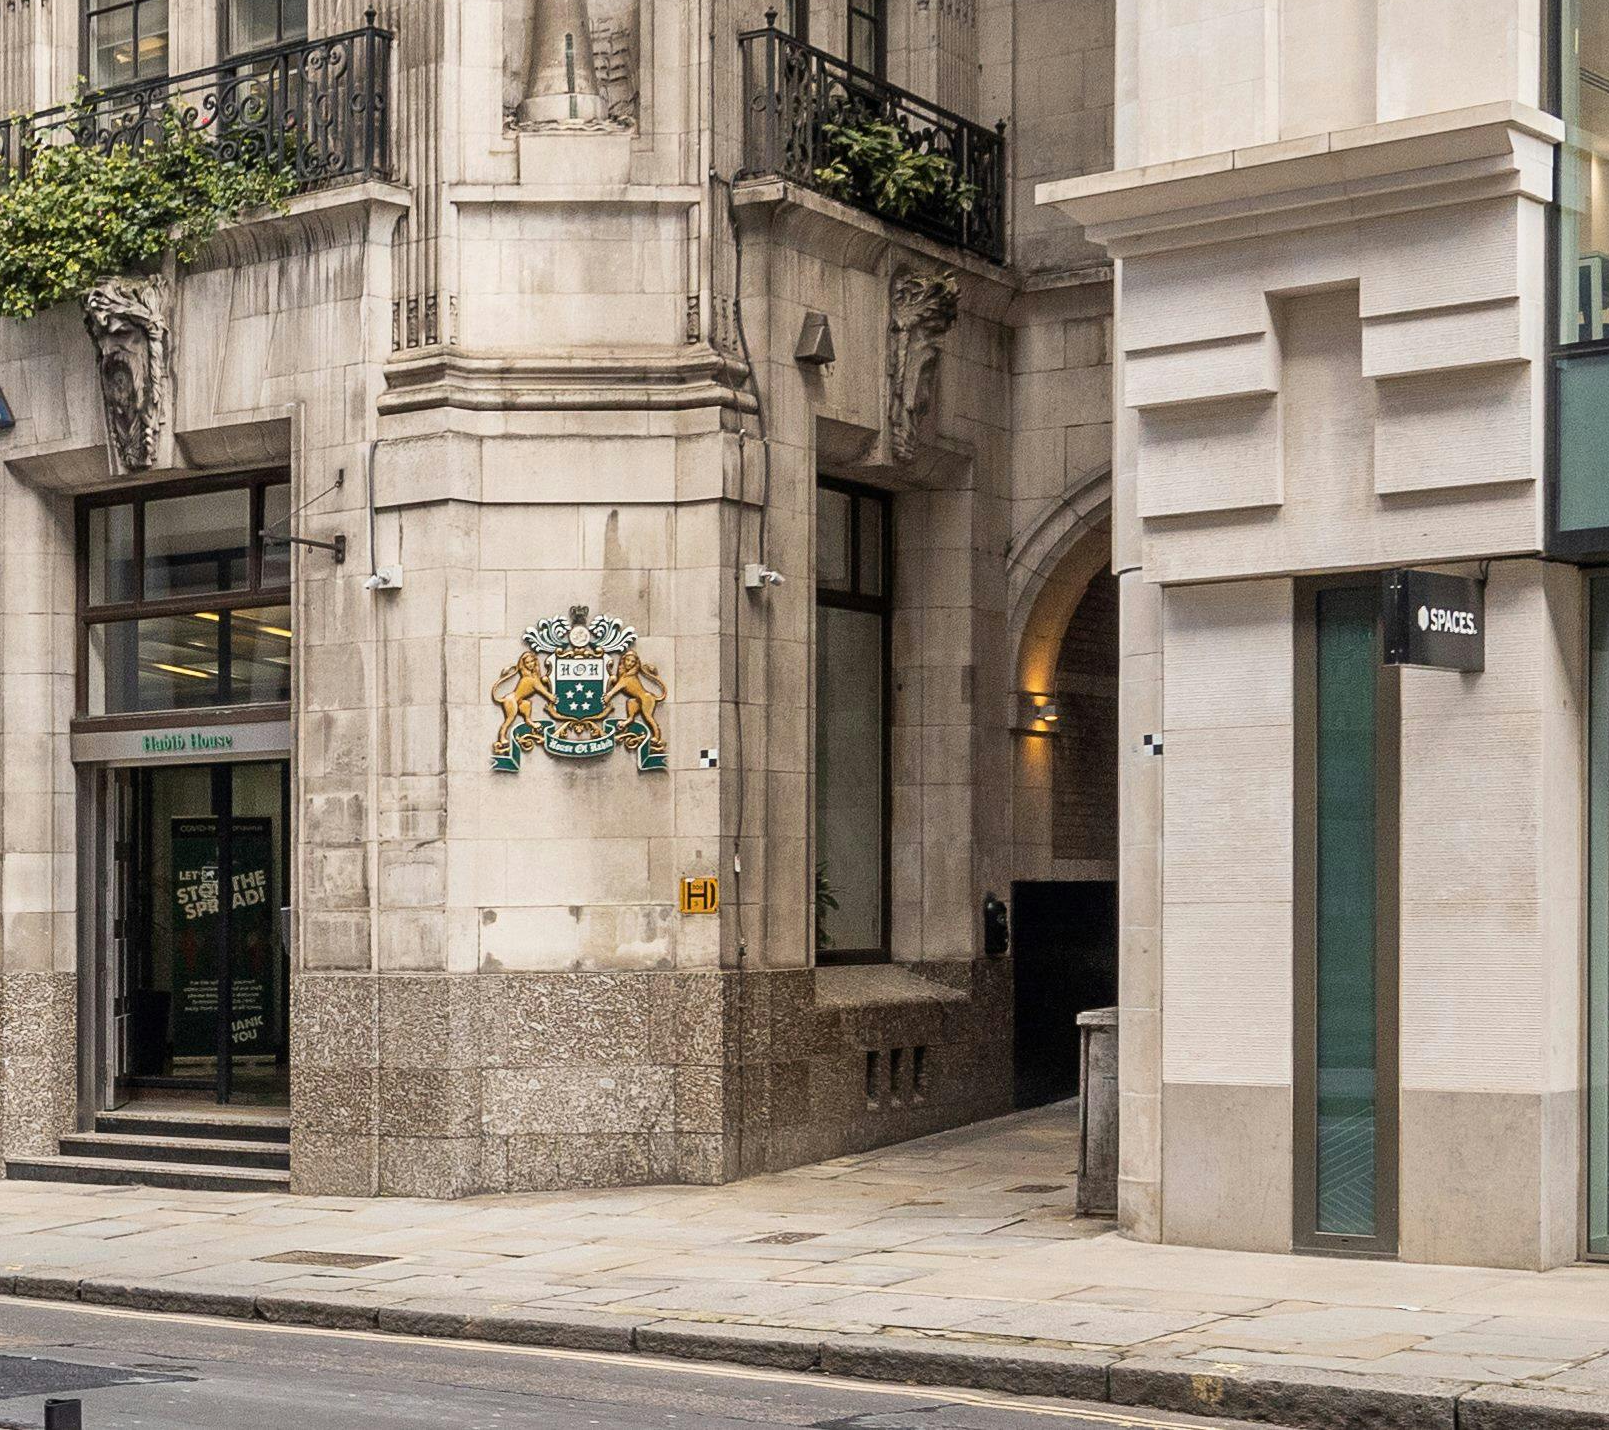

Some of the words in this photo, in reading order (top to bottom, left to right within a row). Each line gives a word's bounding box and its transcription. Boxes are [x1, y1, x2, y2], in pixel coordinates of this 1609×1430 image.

[142, 734, 185, 752] Habib
[190, 732, 233, 750] House
[548, 740, 573, 753] House
[232, 869, 266, 892] THE
[232, 1015, 264, 1032] ANK
[232, 1028, 257, 1043] YOU
